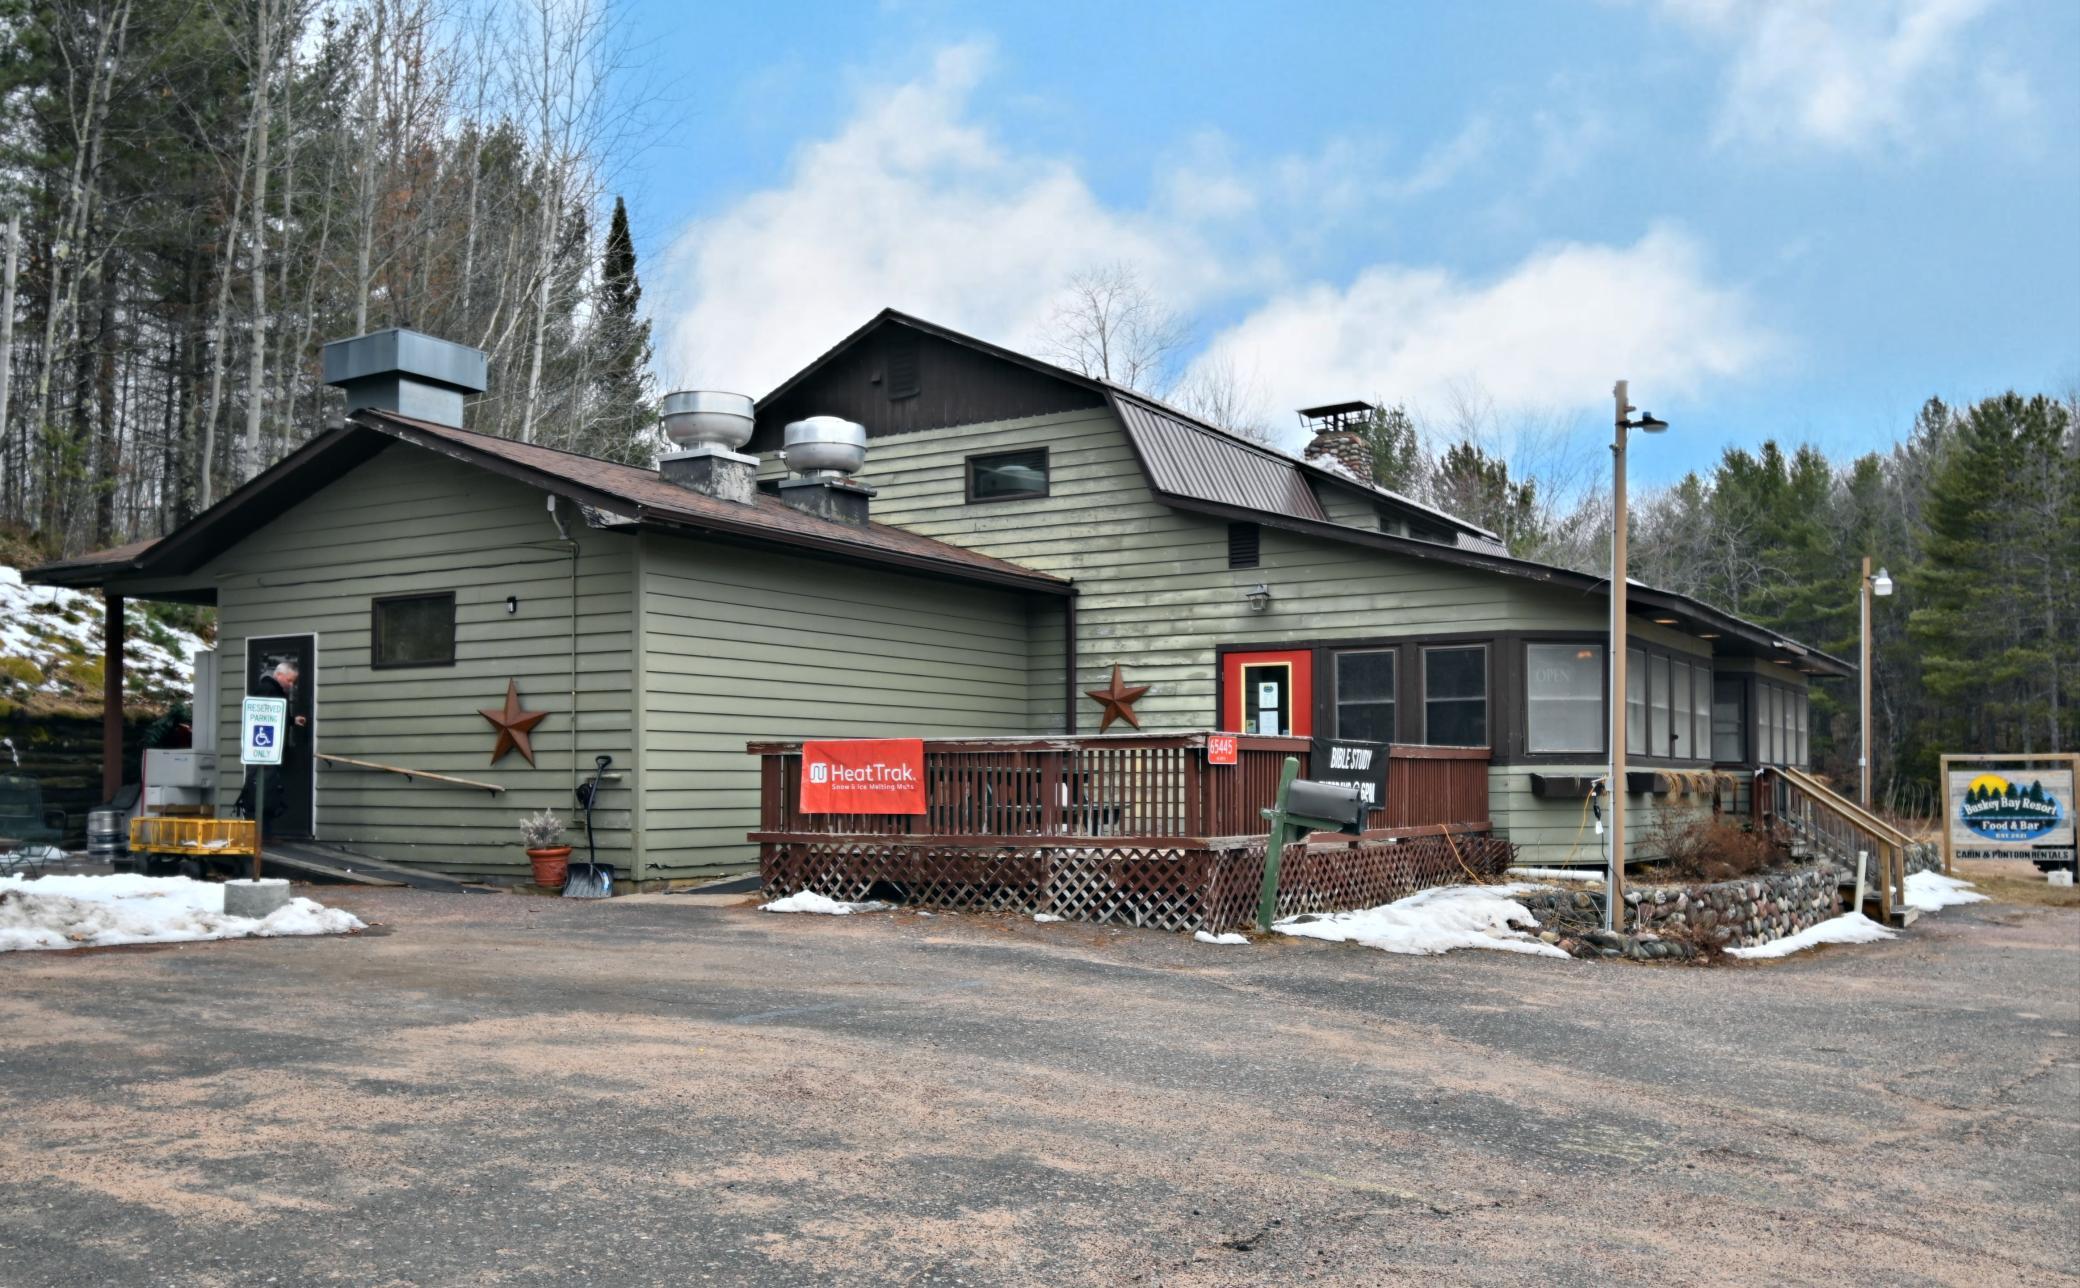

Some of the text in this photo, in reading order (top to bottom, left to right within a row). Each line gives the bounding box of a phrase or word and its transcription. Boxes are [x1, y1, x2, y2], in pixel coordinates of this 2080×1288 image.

[1536, 667, 1570, 682] OPEN
[247, 703, 281, 713] RESERVED
[250, 713, 278, 723] PARKING
[1210, 739, 1233, 755] 65445
[253, 749, 271, 758] ONLY
[1330, 747, 1372, 770] BIBLE STUDY
[869, 783, 895, 791] Melting
[1360, 782, 1376, 803] 6PM
[1964, 797, 2058, 815] Buskey Bay Resort
[1982, 820, 2040, 830] Food & Bar
[1956, 849, 2069, 859] CABIN & PONTOON RENTALS
